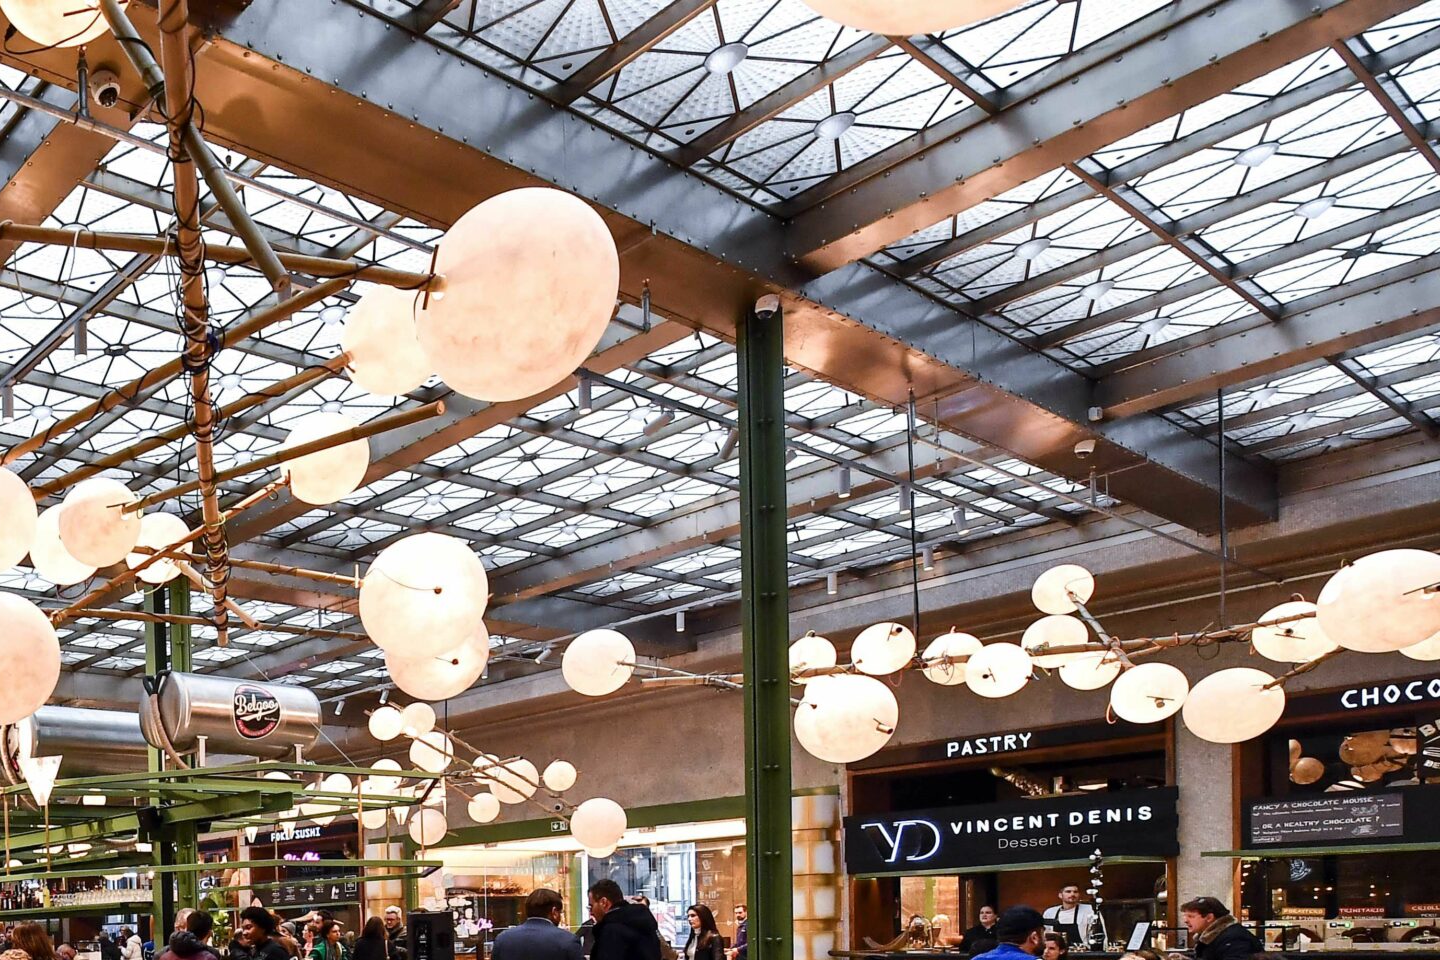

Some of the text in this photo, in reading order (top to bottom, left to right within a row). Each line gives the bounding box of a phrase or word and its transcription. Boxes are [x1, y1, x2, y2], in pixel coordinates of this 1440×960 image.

[234, 693, 279, 721] Belgoo
[946, 732, 1033, 757] PASTRY
[1291, 799, 1339, 808] CHOCOLATE
[1342, 796, 1374, 804] MOUSSE
[950, 805, 1153, 835] VINCENT DENIS
[1284, 819, 1320, 828] HEALTHY
[1322, 816, 1373, 825] CHOCOLATE
[998, 832, 1099, 850] Dessert bar
